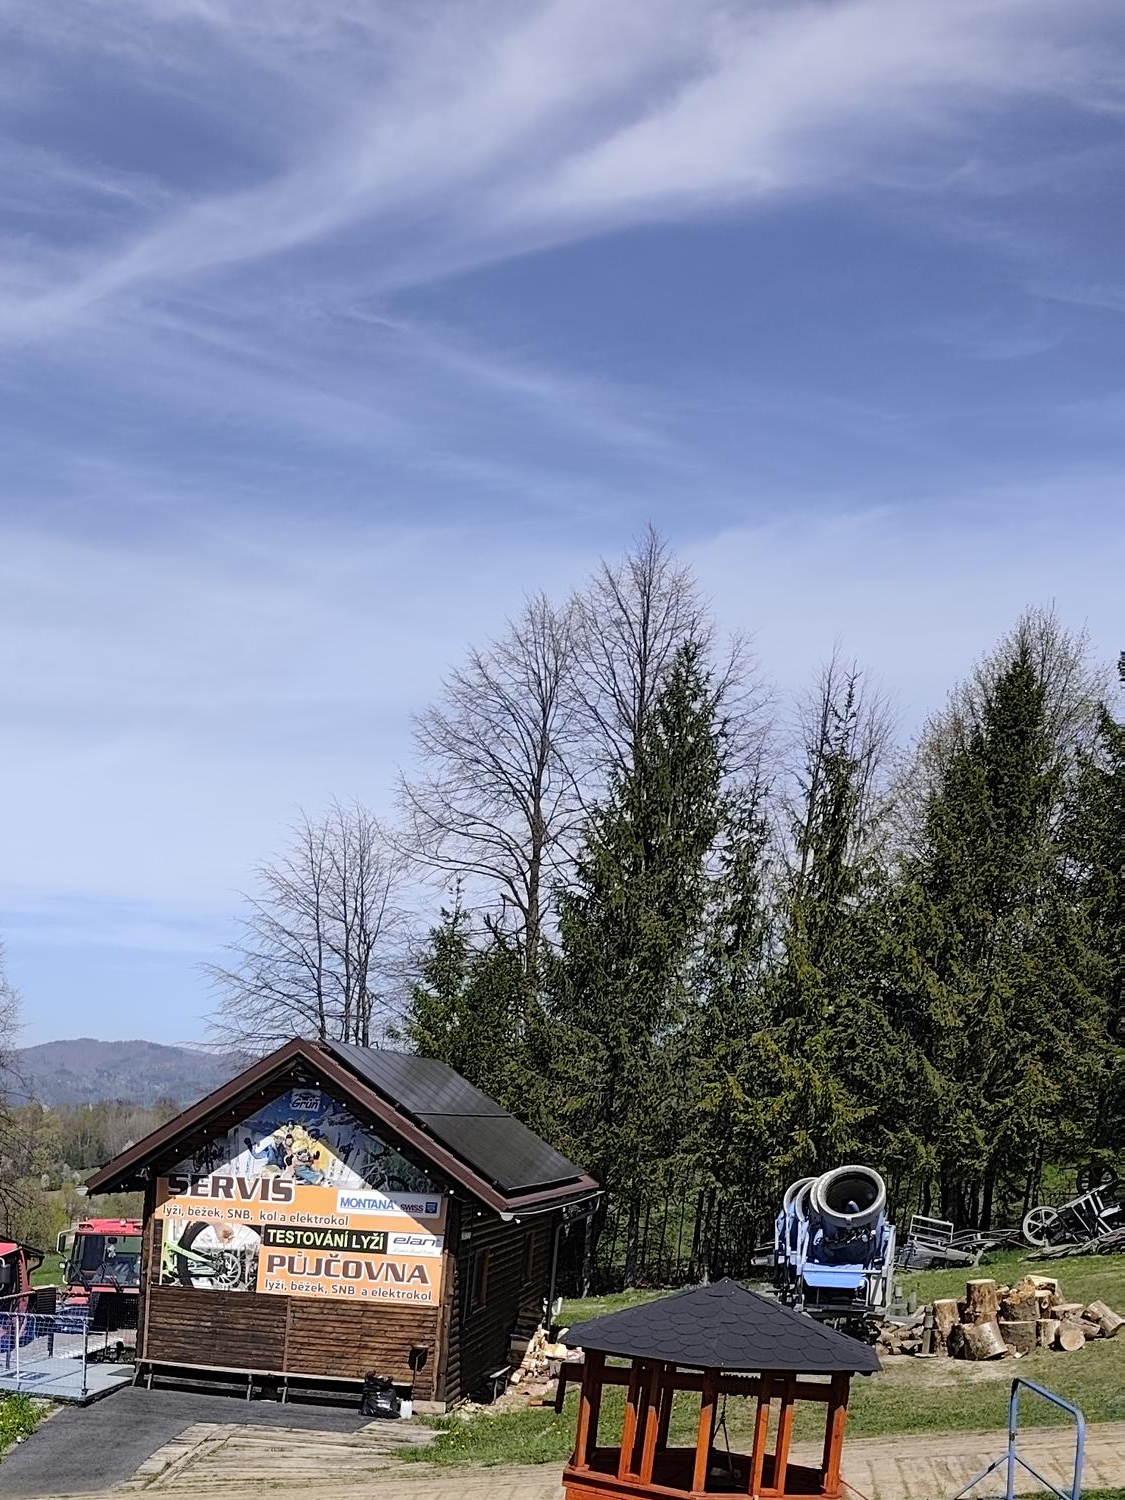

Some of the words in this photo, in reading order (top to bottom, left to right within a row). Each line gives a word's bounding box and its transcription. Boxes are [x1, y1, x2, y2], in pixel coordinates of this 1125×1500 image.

[168, 1174, 293, 1202] SERVIS
[340, 1197, 395, 1210] MONTANA
[400, 1203, 424, 1212] SWISS
[163, 1205, 184, 1217] lyži,
[188, 1206, 223, 1219] běžek,
[227, 1208, 253, 1220] SNB,
[260, 1210, 277, 1221] kol
[280, 1214, 286, 1222] a
[289, 1213, 349, 1226] elektrokol
[267, 1229, 349, 1248] TESTOVÁNÍ
[352, 1232, 384, 1250] LYŽÍ
[393, 1236, 436, 1247] elan
[267, 1251, 429, 1284] PŮJČOVNA
[265, 1279, 287, 1291] lyži,
[291, 1281, 328, 1295] běžek,
[331, 1284, 355, 1295] SNB
[361, 1289, 368, 1297] a
[371, 1289, 432, 1301] elektrokol
